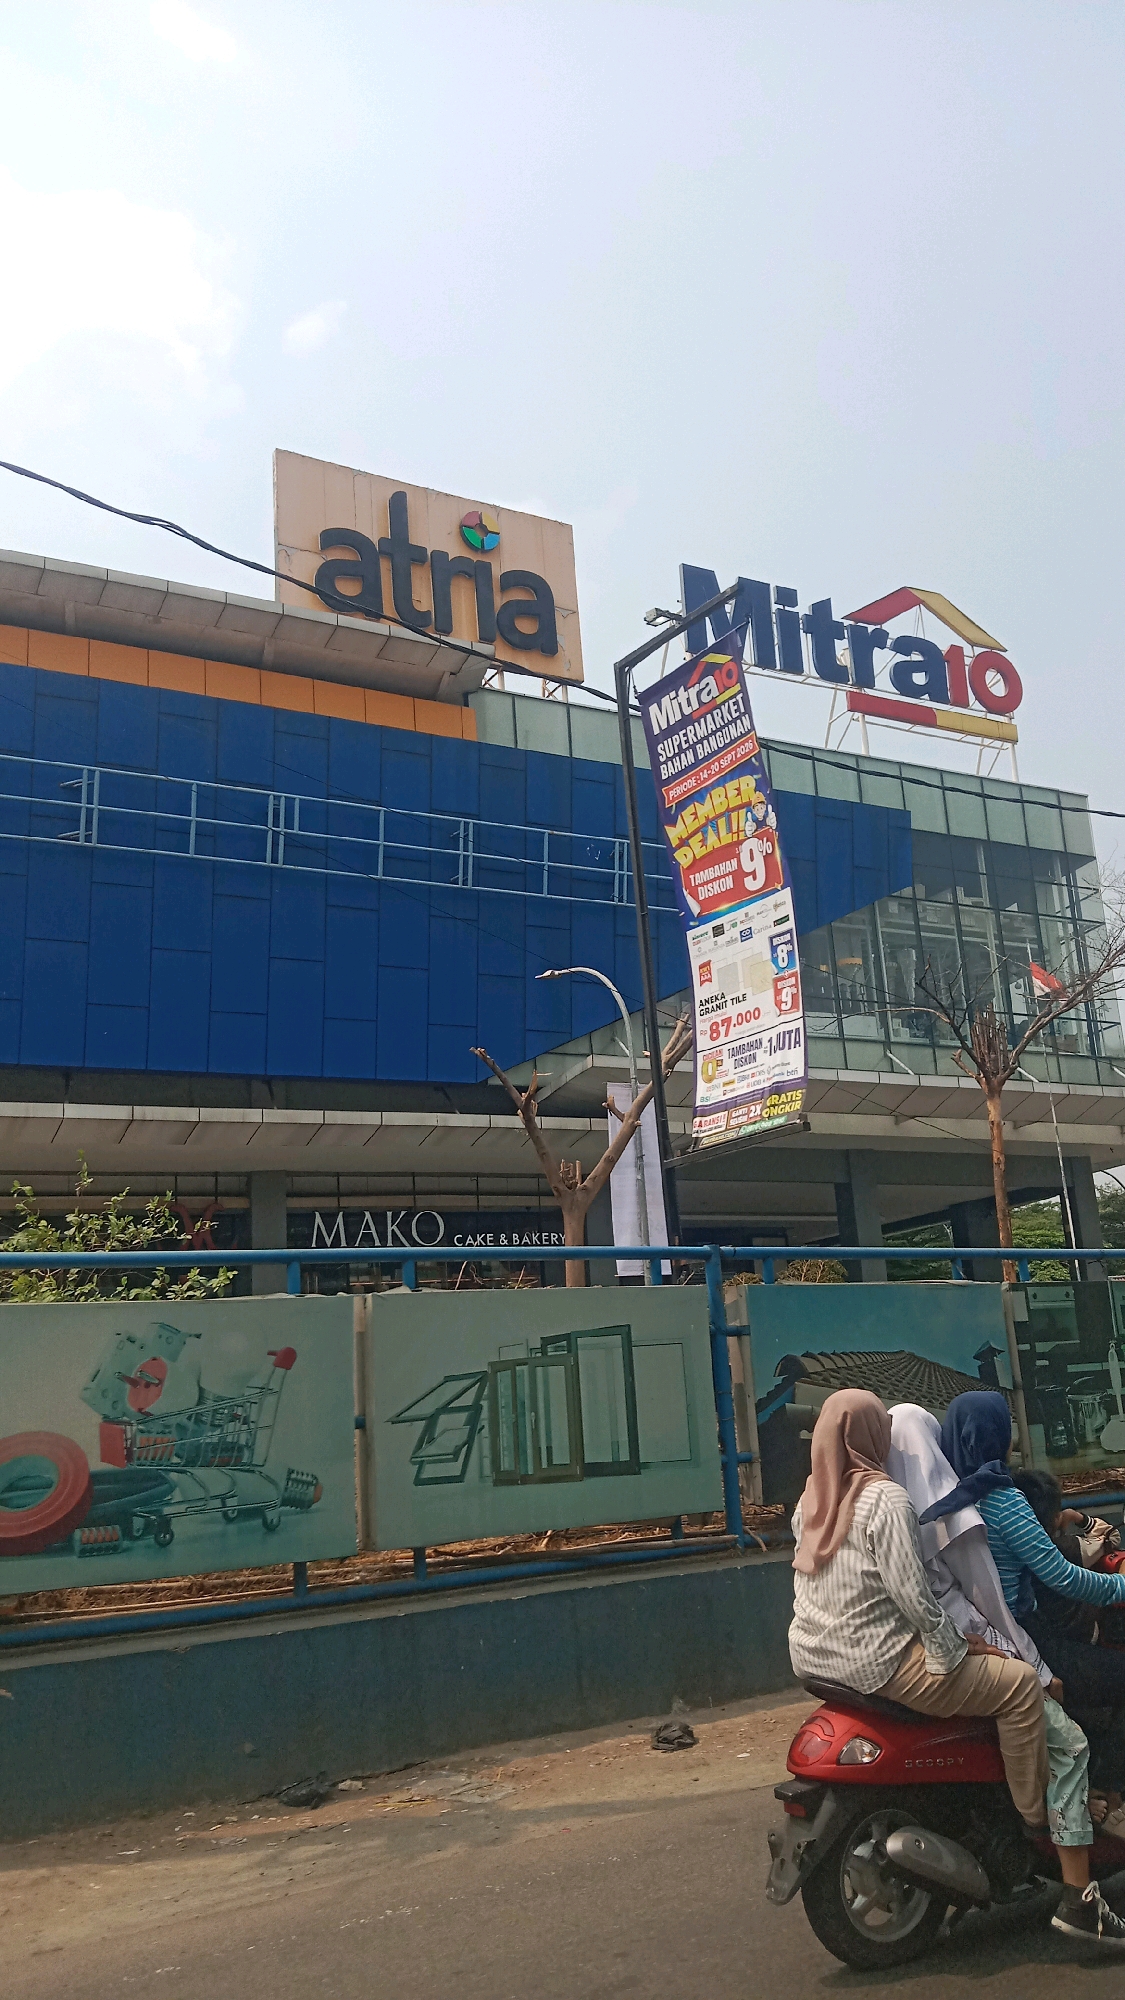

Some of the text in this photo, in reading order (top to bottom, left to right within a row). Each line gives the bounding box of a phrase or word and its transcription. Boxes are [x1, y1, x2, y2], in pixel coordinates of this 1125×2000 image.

[314, 491, 559, 656] atria
[679, 563, 1024, 715] Mitra10
[648, 660, 739, 736] Mitra10
[657, 693, 745, 763] SUPERMARKET
[660, 713, 752, 780] BAHAN BANGUNAN
[720, 750, 736, 768] SEPT
[664, 775, 757, 848] MEMBER
[673, 807, 747, 869] DEAL!!
[689, 857, 738, 887] TAMBAHAN
[740, 837, 773, 892] 9%
[697, 874, 734, 900] DISKON
[699, 992, 726, 1008] ANEKA
[699, 993, 747, 1017] GRANIT TILE
[709, 1006, 761, 1041] 87.000
[728, 1037, 763, 1059] TAMBAHAN
[734, 1052, 757, 1070] DISKON
[749, 1103, 763, 1119] 2X
[761, 1101, 802, 1118] ONGKIR
[766, 1090, 803, 1107] GRATIS
[311, 1210, 566, 1247] MAKO CAKE & BAKERY
[905, 1758, 964, 1768] SCOOPY
